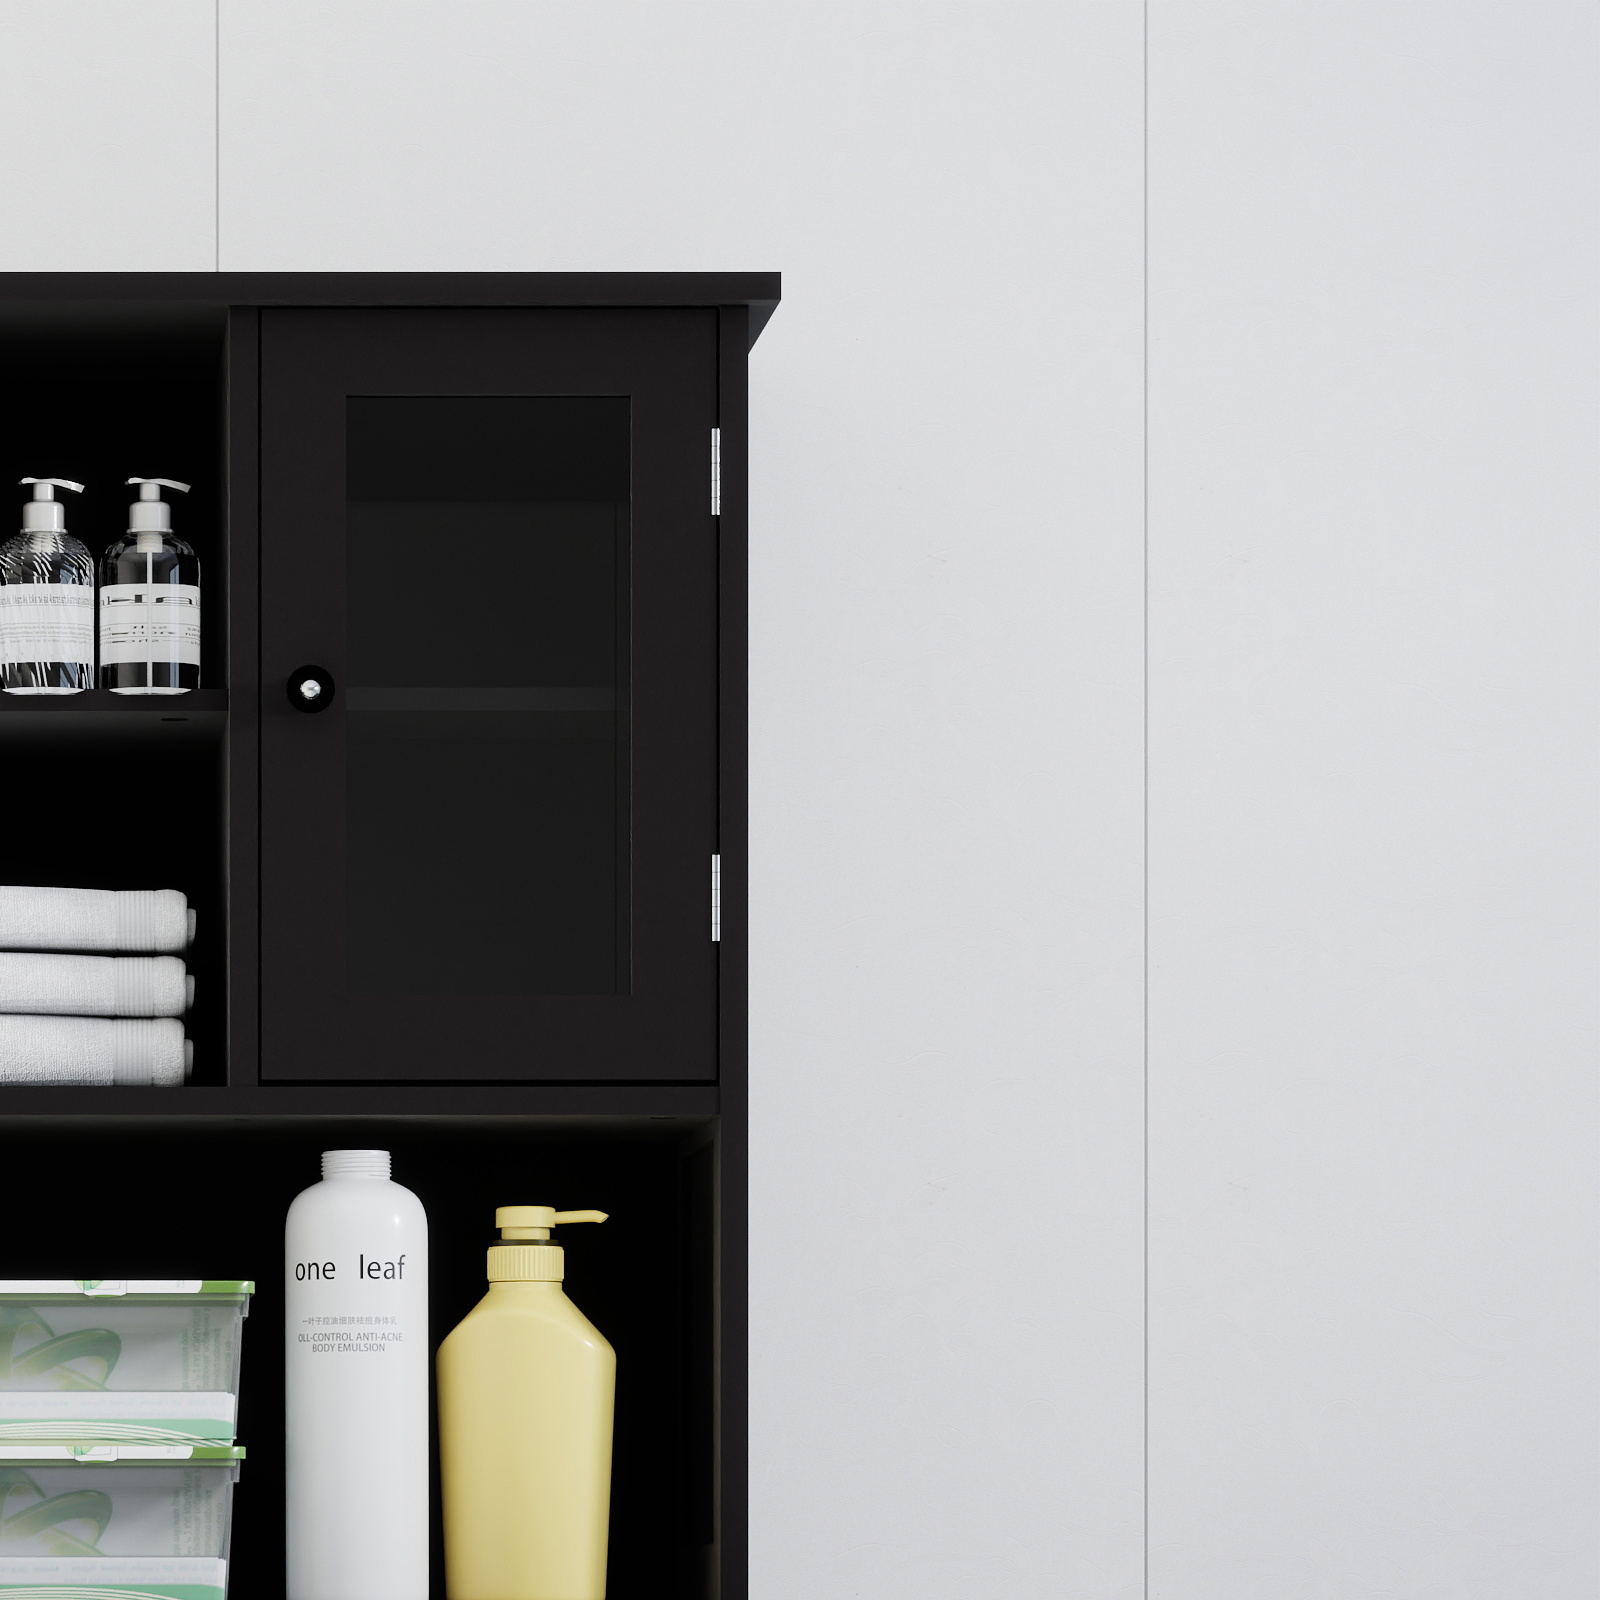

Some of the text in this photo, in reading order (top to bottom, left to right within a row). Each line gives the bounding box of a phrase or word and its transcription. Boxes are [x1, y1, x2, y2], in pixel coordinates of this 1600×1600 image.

[295, 1254, 406, 1281] one leaf
[356, 1332, 403, 1342] ANTI-ACNE
[312, 1343, 385, 1353] BODY EMULSION
